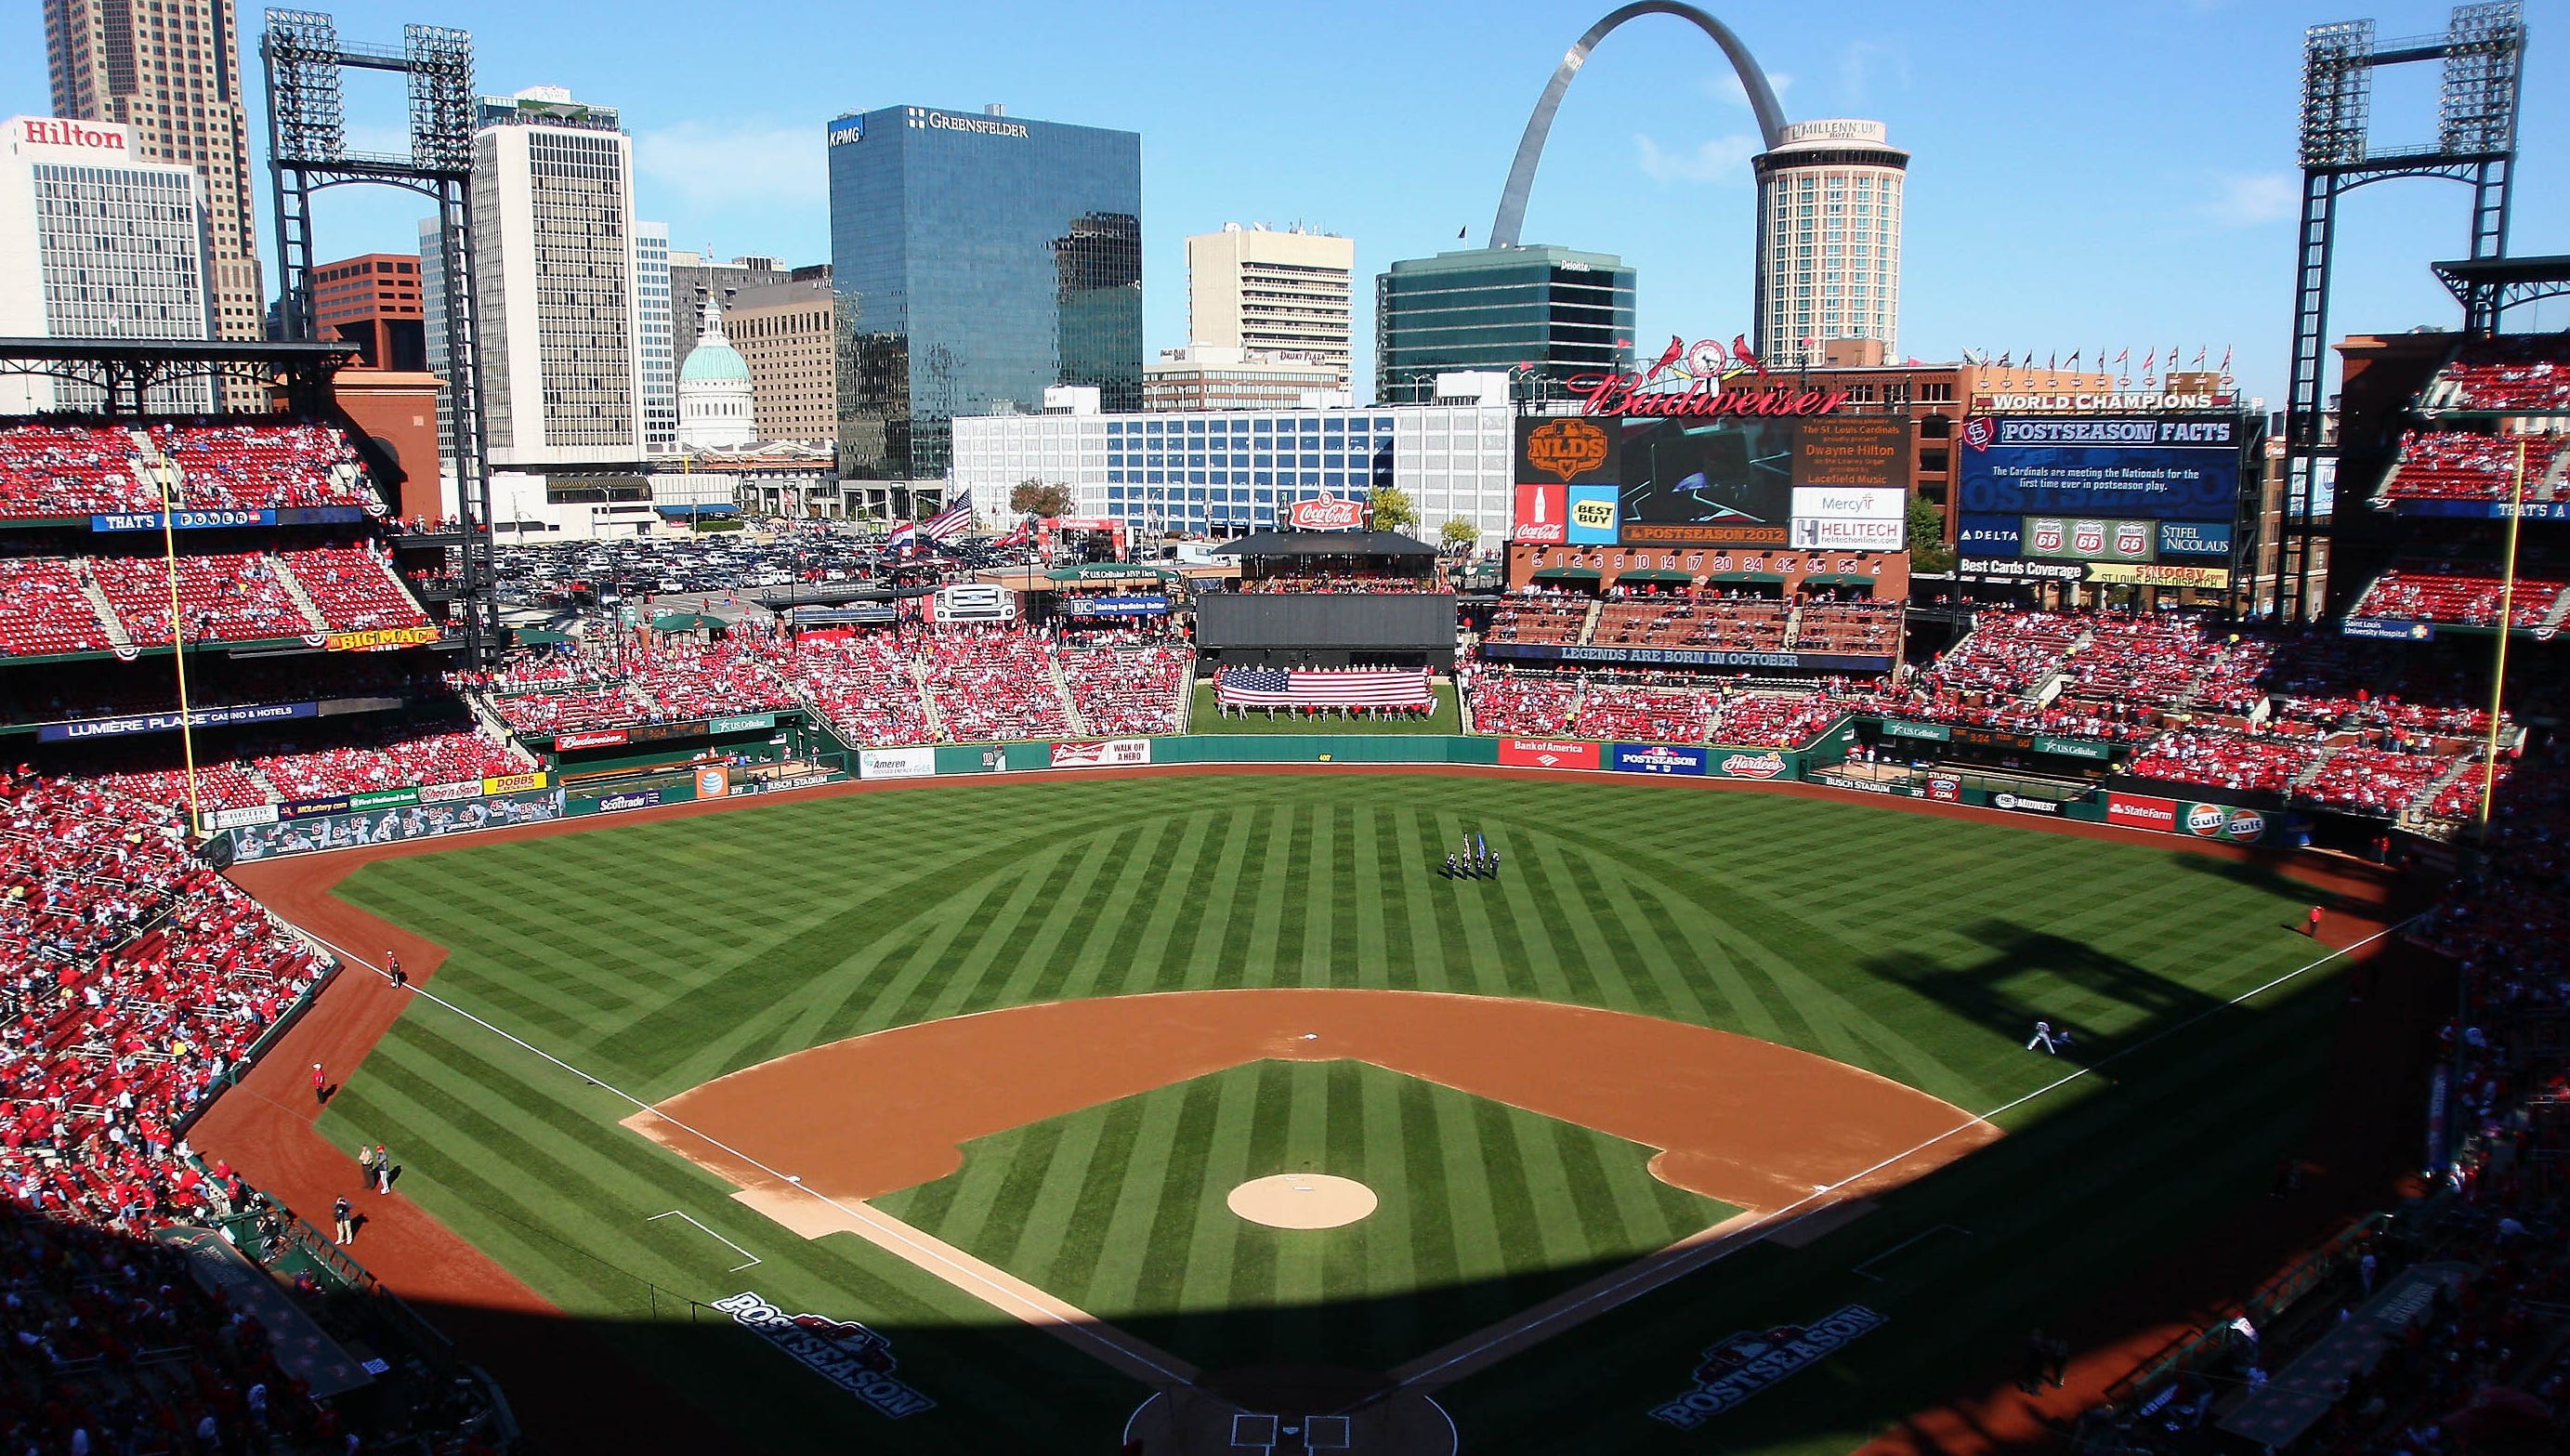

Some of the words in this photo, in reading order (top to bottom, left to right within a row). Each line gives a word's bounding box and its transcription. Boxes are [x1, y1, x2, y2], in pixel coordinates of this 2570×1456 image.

[929, 111, 1029, 138] GREENSFELDER
[23, 120, 125, 149] Hilton
[829, 126, 859, 147] KPMG
[1567, 373, 1850, 416] Budweiser
[1994, 394, 2073, 410] WORLD
[2076, 394, 2212, 410] CHAMPIONS
[1803, 426, 1818, 434] The
[1836, 426, 1857, 435] Louis
[1860, 426, 1900, 435] Cardinals
[2005, 423, 2155, 441] POSTSEASON
[2161, 424, 2230, 441] FACTS
[1530, 438, 1606, 458] NLDS
[1806, 445, 1855, 459] Dwayne
[1858, 446, 1895, 456] Hilton
[1993, 466, 2007, 476] The
[2010, 466, 2049, 477] Cardinals
[2068, 468, 2103, 479] meeting
[2105, 468, 2119, 478] the
[2122, 467, 2165, 479] Nationals
[2168, 468, 2181, 479] for
[2183, 469, 2199, 479] the
[1808, 475, 1855, 483] Lacefield
[1858, 475, 1887, 484] Music
[2019, 478, 2038, 488] first
[2040, 479, 2059, 489] time
[2061, 480, 2081, 490] ever
[2083, 479, 2091, 489] in
[2093, 480, 2144, 491] postseason
[2145, 480, 2168, 493] play.
[1578, 505, 1613, 516] BEST
[1822, 497, 1863, 513] Mercy
[2554, 505, 2565, 517] A
[1300, 505, 1354, 523] Coca-Cola
[1579, 515, 1609, 524] BUY
[106, 515, 155, 529] THAT'S
[1516, 523, 1563, 540] Coca-Cola
[1821, 523, 1897, 536] HELITECH
[1974, 531, 2018, 541] DELTA
[2163, 525, 2199, 539] STIFEL
[1821, 536, 1897, 544] helitechonline.com
[2038, 534, 2058, 546] 66
[2078, 536, 2099, 548] 66
[2120, 537, 2141, 550] 66
[2167, 538, 2229, 552] NICOLAUS
[1556, 553, 1563, 568] 1
[1573, 554, 1583, 569] 2
[1593, 554, 1604, 569] 6
[1614, 554, 1624, 570] 9
[1635, 555, 1650, 570] 10
[1660, 555, 1676, 571] 14
[1687, 555, 1704, 571] 17
[1713, 556, 1733, 571] 20
[1743, 557, 1764, 571] 24
[1775, 557, 1796, 573] 42
[1805, 558, 1827, 573] 45
[1837, 558, 1858, 574] 85
[1961, 558, 1988, 573] Best
[1990, 559, 2025, 574] Cards
[2026, 562, 2081, 580] Coverage
[1074, 602, 1093, 612] BJC
[2345, 627, 2379, 636] University
[2380, 629, 2407, 638] Hospital
[340, 632, 376, 649] BIG
[376, 630, 427, 645] MAC
[370, 643, 400, 651] LAND
[1561, 647, 1627, 661] LEGENDS
[1630, 649, 1662, 662] ARE
[1664, 650, 1705, 664] BORN
[1709, 653, 1725, 664] IN
[1729, 653, 1799, 667] OCTOBER
[68, 719, 144, 737] LUMIÈRE
[150, 714, 207, 729] PLACE
[256, 706, 293, 717] HOTELS
[559, 734, 623, 749] Budweiser
[1114, 743, 1132, 752] WALK
[1134, 743, 1145, 752] OFF
[1514, 741, 1536, 750] Bank
[1537, 742, 1546, 751] of
[1547, 742, 1583, 753] America
[1053, 747, 1103, 760] Budweiser
[1118, 753, 1122, 761] A
[1123, 753, 1141, 761] HERO
[2069, 745, 2098, 756] Cellular
[982, 752, 994, 763] 10
[1622, 754, 1698, 767] POSTSEASON
[873, 760, 905, 769] Ameren
[497, 775, 534, 788] DOBBS
[767, 779, 793, 791] BUSCH
[793, 774, 829, 788] STADIUM
[1928, 771, 1961, 782] STLFORD
[457, 783, 479, 795] Save
[1826, 777, 1854, 789] BUSCH
[1855, 781, 1890, 794] STADIUM
[373, 794, 400, 804] National
[400, 792, 416, 801] Bank
[600, 794, 646, 811] Scottrade
[490, 799, 504, 812] 45
[519, 802, 533, 815] 85
[429, 807, 443, 820] 24
[459, 810, 475, 823] 42
[2125, 805, 2149, 817] State
[2148, 807, 2172, 820] Farm
[351, 818, 363, 829] 14
[379, 820, 390, 833] 17
[403, 818, 418, 829] 20
[2191, 814, 2223, 827] Gulf
[2230, 819, 2262, 833] Gulf
[267, 828, 273, 841] 1
[311, 822, 321, 835] 6
[334, 826, 343, 839] 9
[285, 833, 295, 845] 2
[715, 1292, 932, 1415] POSTSEASON
[1662, 1305, 1882, 1425] POSTSEASON
